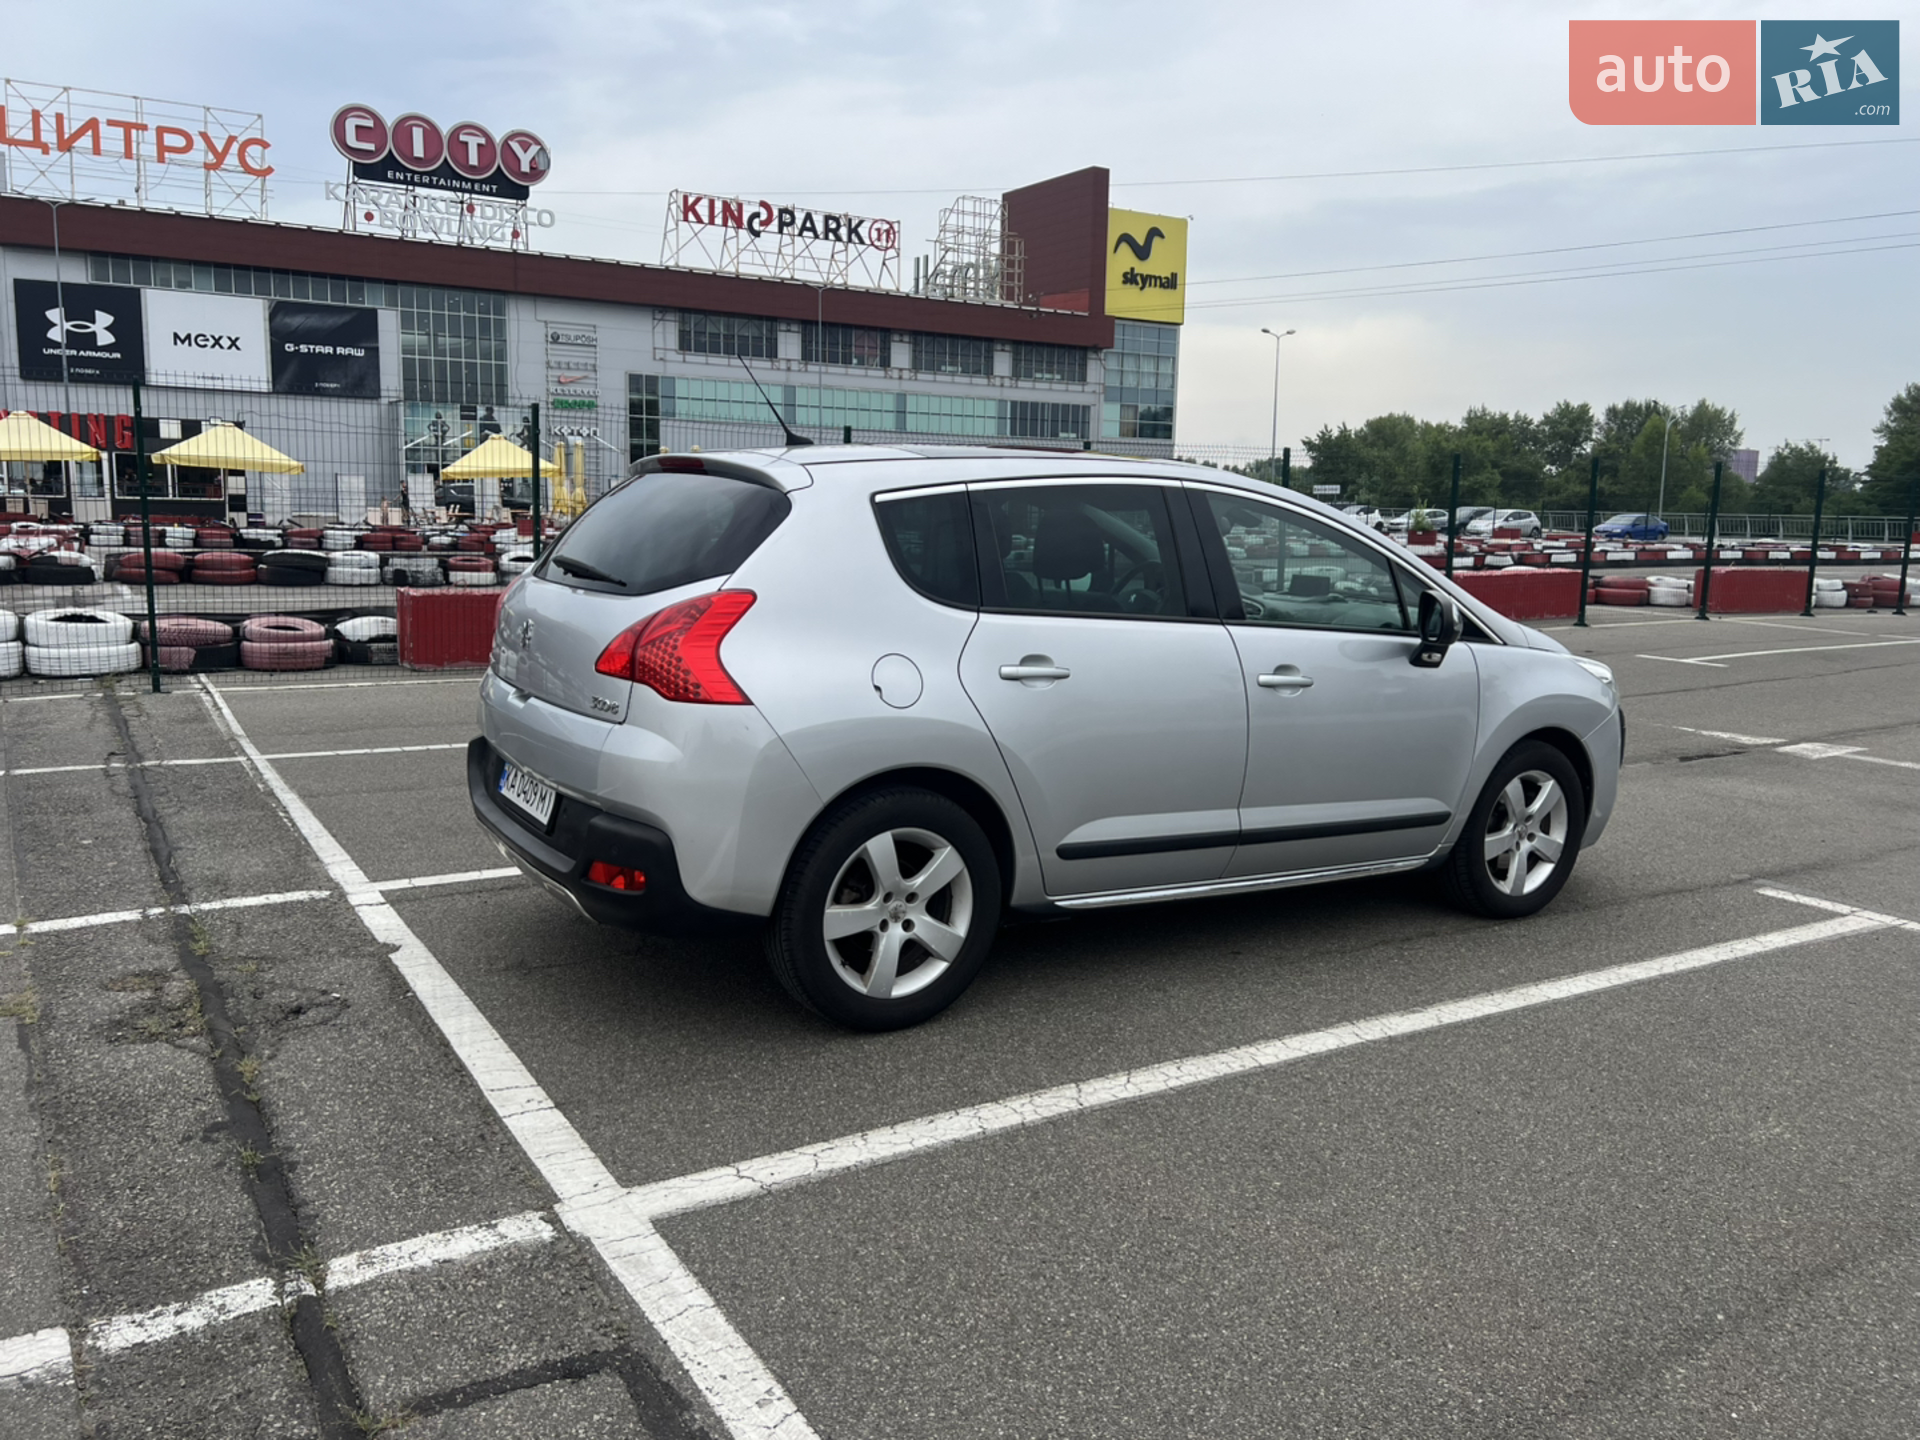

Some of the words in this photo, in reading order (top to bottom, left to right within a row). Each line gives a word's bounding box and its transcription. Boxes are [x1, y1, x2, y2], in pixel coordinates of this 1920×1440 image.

[0, 105, 275, 177] ЦИТРУС
[345, 116, 542, 174] CITY
[387, 170, 499, 193] ENTERTAINMENT
[324, 180, 461, 217] KARAOKE
[478, 201, 556, 228] DISCO
[378, 209, 507, 242] BOWLING
[1122, 266, 1178, 292] skymall
[78, 349, 122, 360] ARMOUR
[336, 345, 365, 357] RAW
[550, 386, 602, 397] RESERVED
[590, 695, 620, 715] 3008
